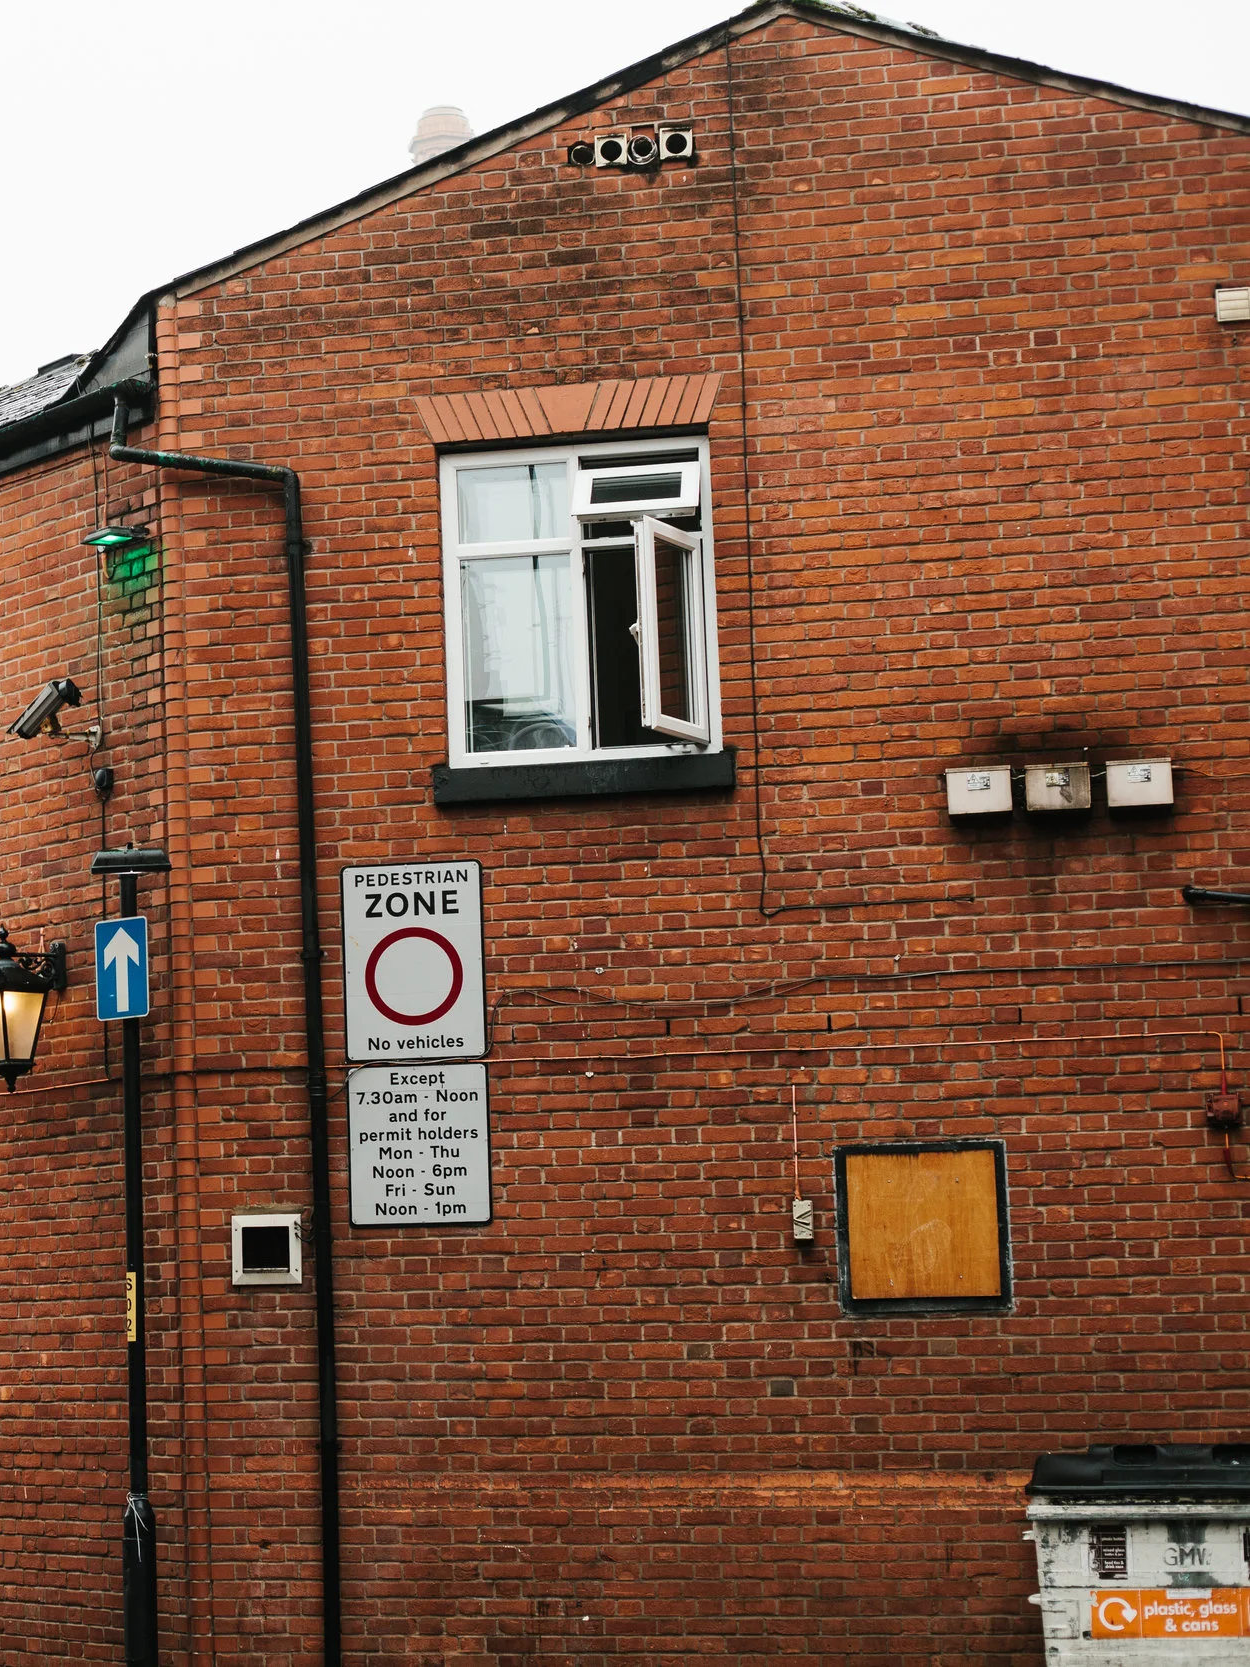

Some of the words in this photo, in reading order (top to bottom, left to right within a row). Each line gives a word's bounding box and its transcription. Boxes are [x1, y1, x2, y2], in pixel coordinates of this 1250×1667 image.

[354, 869, 469, 888] PEDESTRIAN
[364, 889, 460, 919] ZONE
[367, 1037, 391, 1051] No
[396, 1034, 464, 1050] vehicles
[389, 1071, 446, 1087] Except
[356, 1091, 418, 1105] 7.30am
[436, 1089, 479, 1102] Noon
[388, 1109, 418, 1123] and
[423, 1108, 447, 1122] for
[359, 1127, 412, 1144] permit
[418, 1126, 479, 1140] holders
[379, 1146, 413, 1160] Mon
[429, 1145, 460, 1159] Thu
[372, 1165, 415, 1179] Noon
[432, 1163, 468, 1179] 6pm
[385, 1183, 406, 1197] Fri
[423, 1182, 456, 1196] Sun
[375, 1202, 418, 1216] Noon
[434, 1201, 467, 1216] 1pm
[1144, 1600, 1196, 1619] plastic,
[1199, 1600, 1238, 1618] glass
[1165, 1618, 1177, 1632] &
[1181, 1620, 1219, 1632] cans
